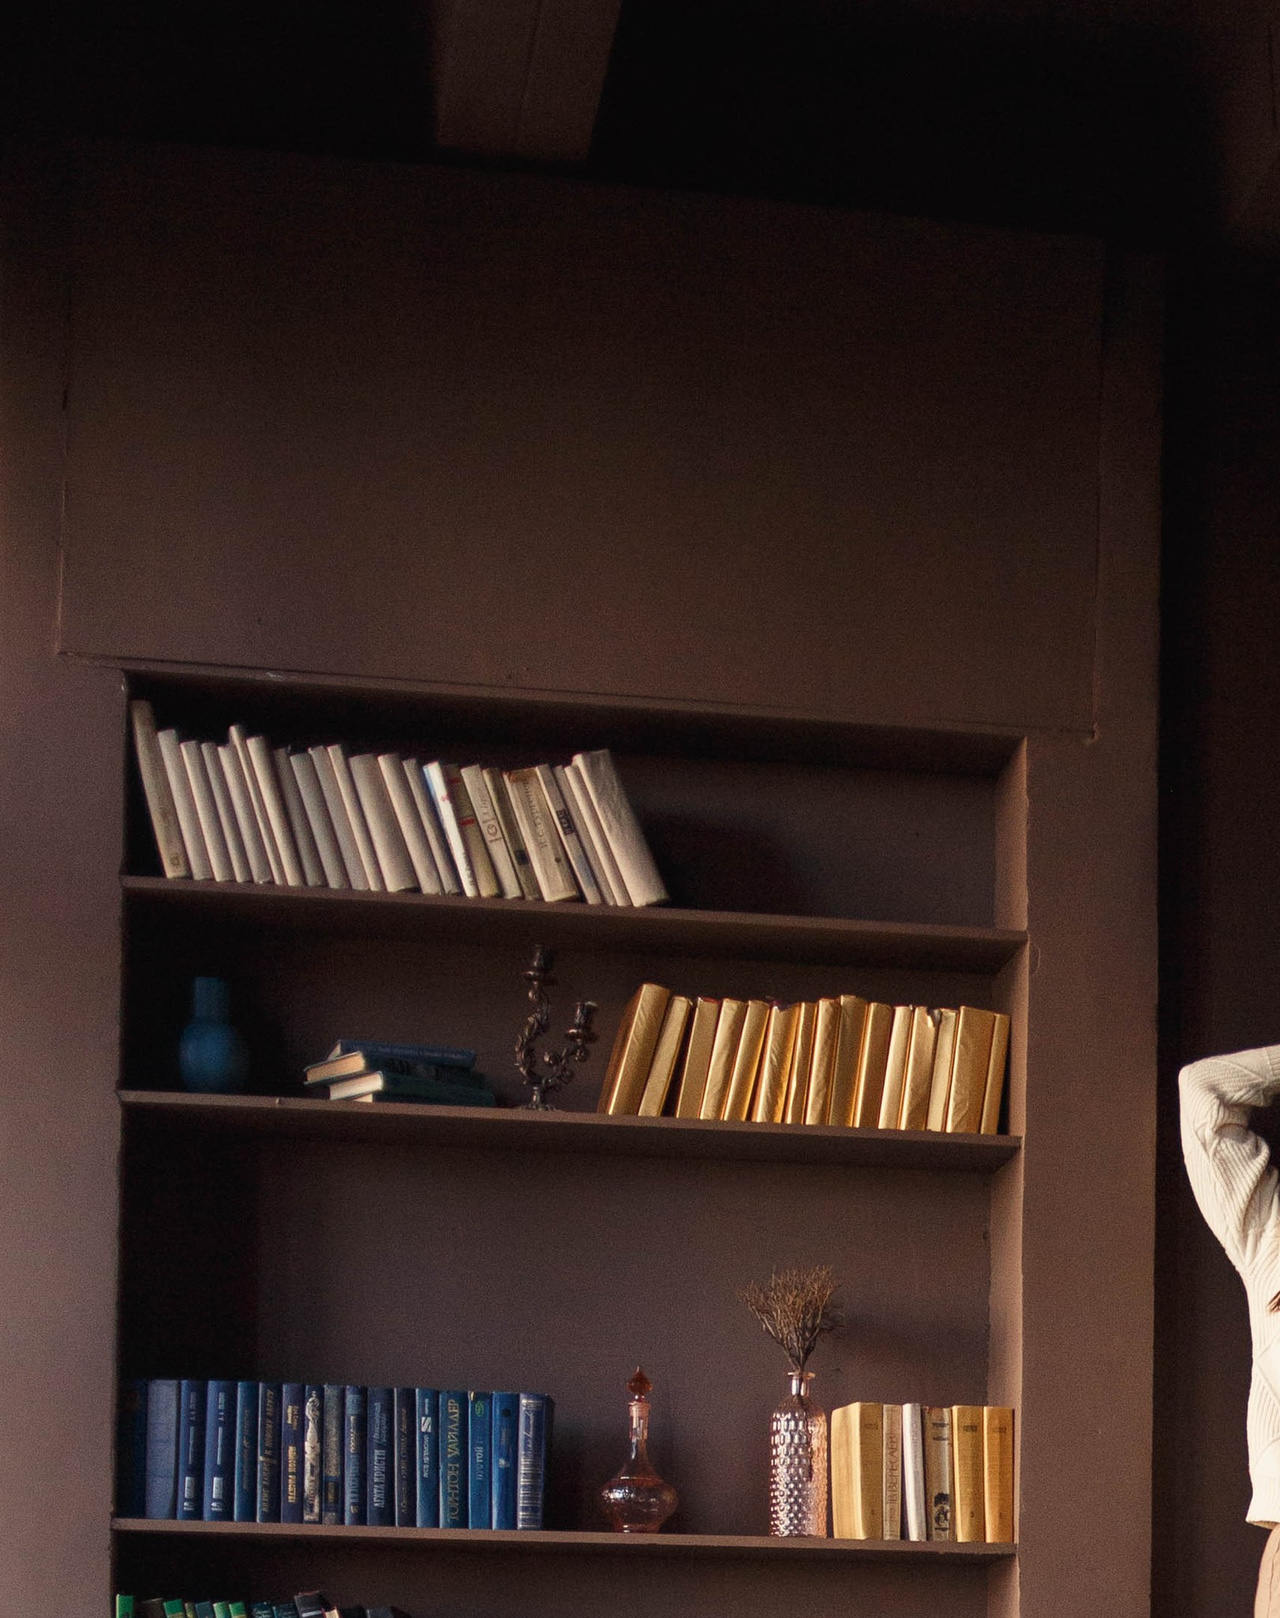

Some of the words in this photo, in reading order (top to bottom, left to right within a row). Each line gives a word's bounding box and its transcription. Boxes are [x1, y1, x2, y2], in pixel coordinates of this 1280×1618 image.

[447, 1399, 460, 1458] УАЙЛДЕР
[374, 1450, 386, 1483] КРИСТИ
[374, 1484, 385, 1508] АГАТА
[447, 1464, 459, 1521] ТОРНТОН
